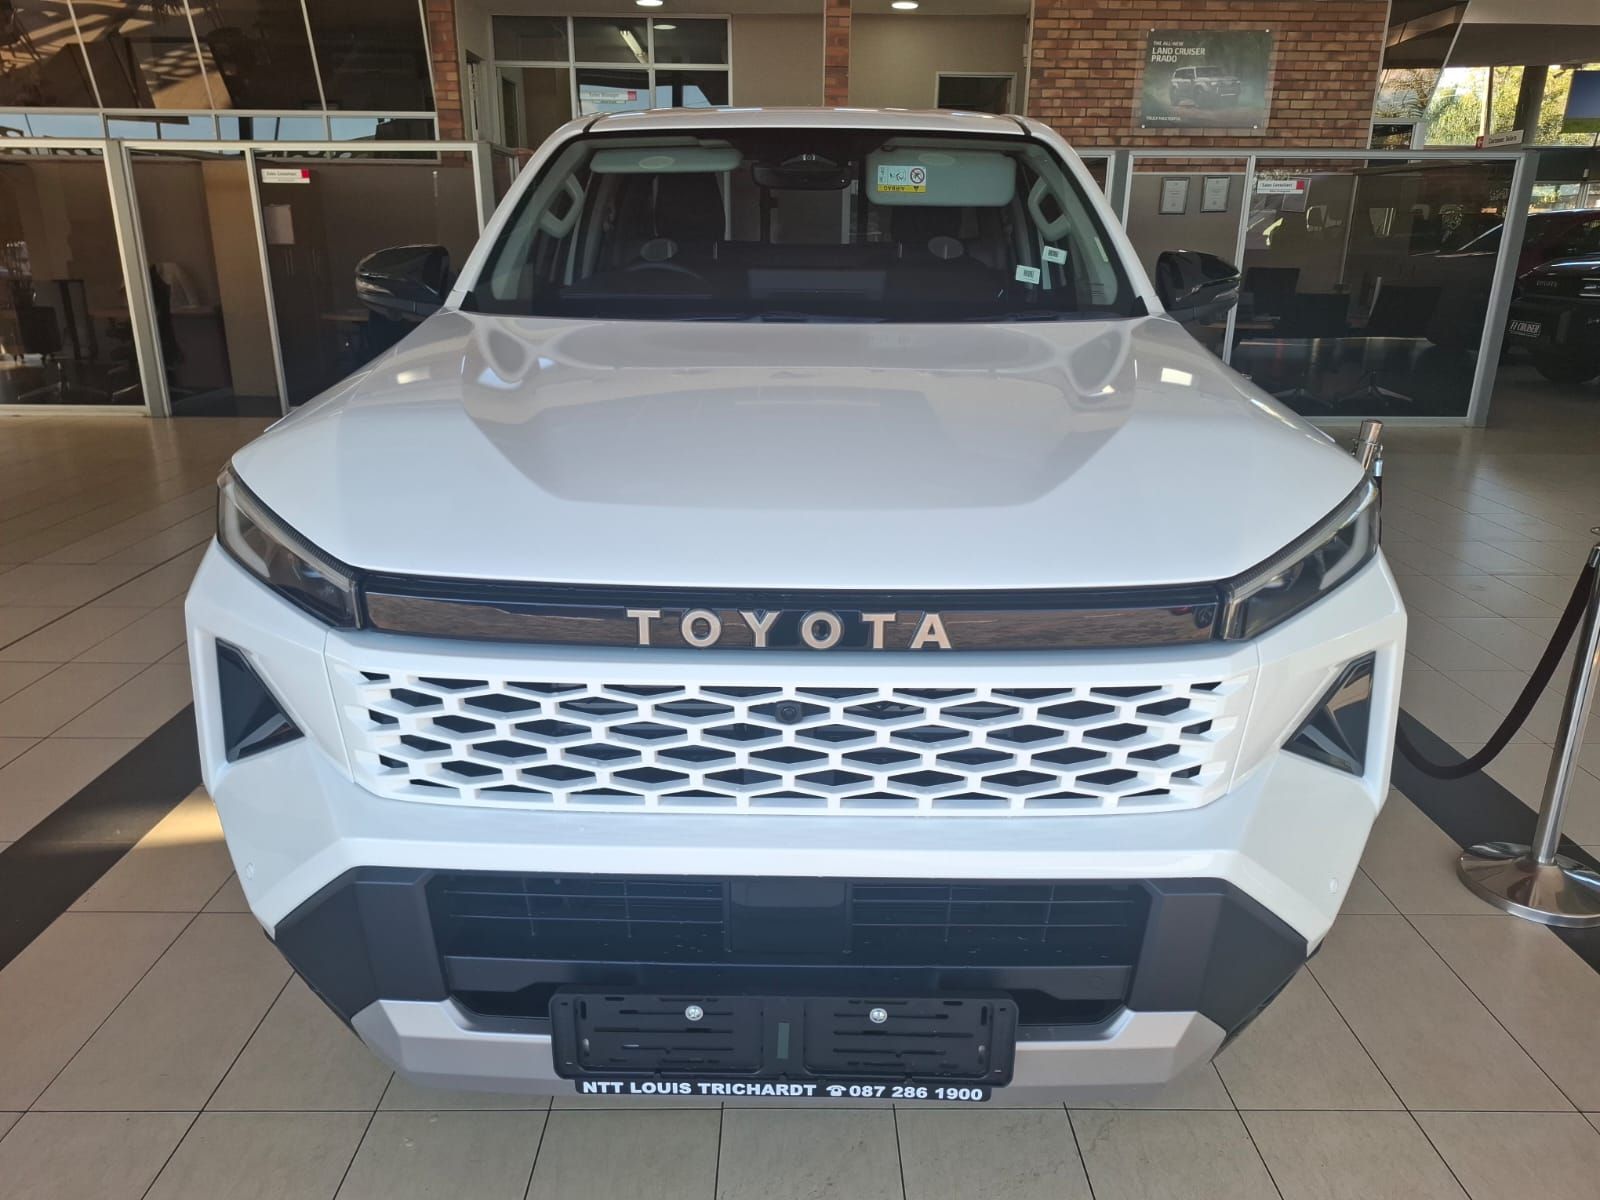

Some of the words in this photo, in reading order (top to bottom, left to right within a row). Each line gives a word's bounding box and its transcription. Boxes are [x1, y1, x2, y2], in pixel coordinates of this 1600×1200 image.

[1152, 47, 1174, 55] LAND
[1174, 47, 1206, 56] CRUISER
[1151, 55, 1178, 63] PRADO
[626, 608, 952, 650] TOYOTA
[582, 1081, 624, 1094] NTT
[629, 1081, 692, 1095] LOUIS
[697, 1082, 817, 1097] TRICHARDT
[849, 1084, 886, 1098] 087
[891, 1086, 928, 1099] 286
[934, 1087, 983, 1101] 1900
